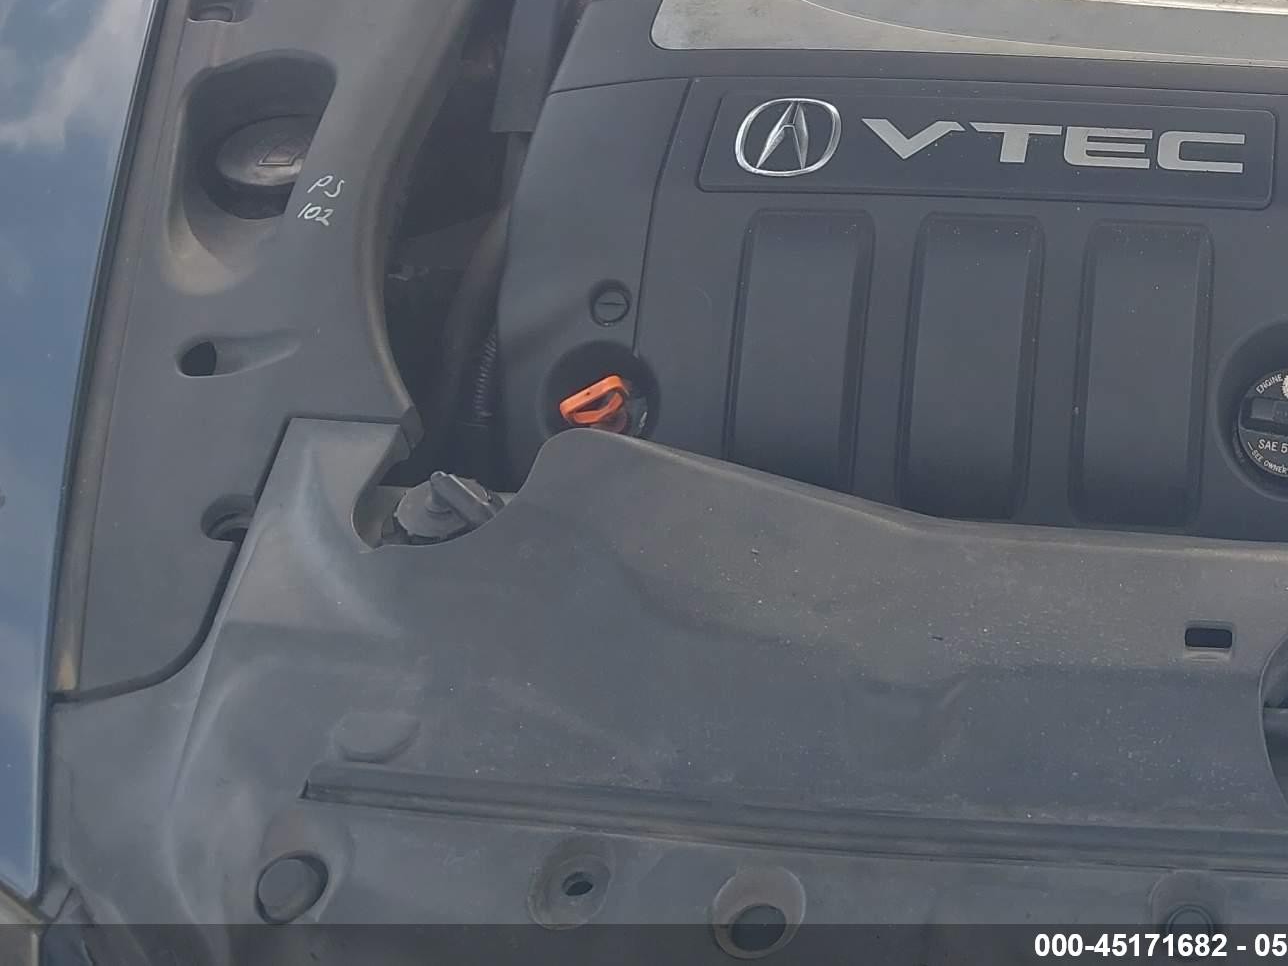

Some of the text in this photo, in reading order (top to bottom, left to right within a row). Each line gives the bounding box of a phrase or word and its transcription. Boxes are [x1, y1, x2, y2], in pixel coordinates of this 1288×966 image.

[861, 118, 1246, 174] VTEC
[297, 202, 334, 226] 102
[1255, 373, 1284, 394] ENGINE
[1258, 438, 1279, 452] SAE
[1251, 449, 1264, 463] SEE
